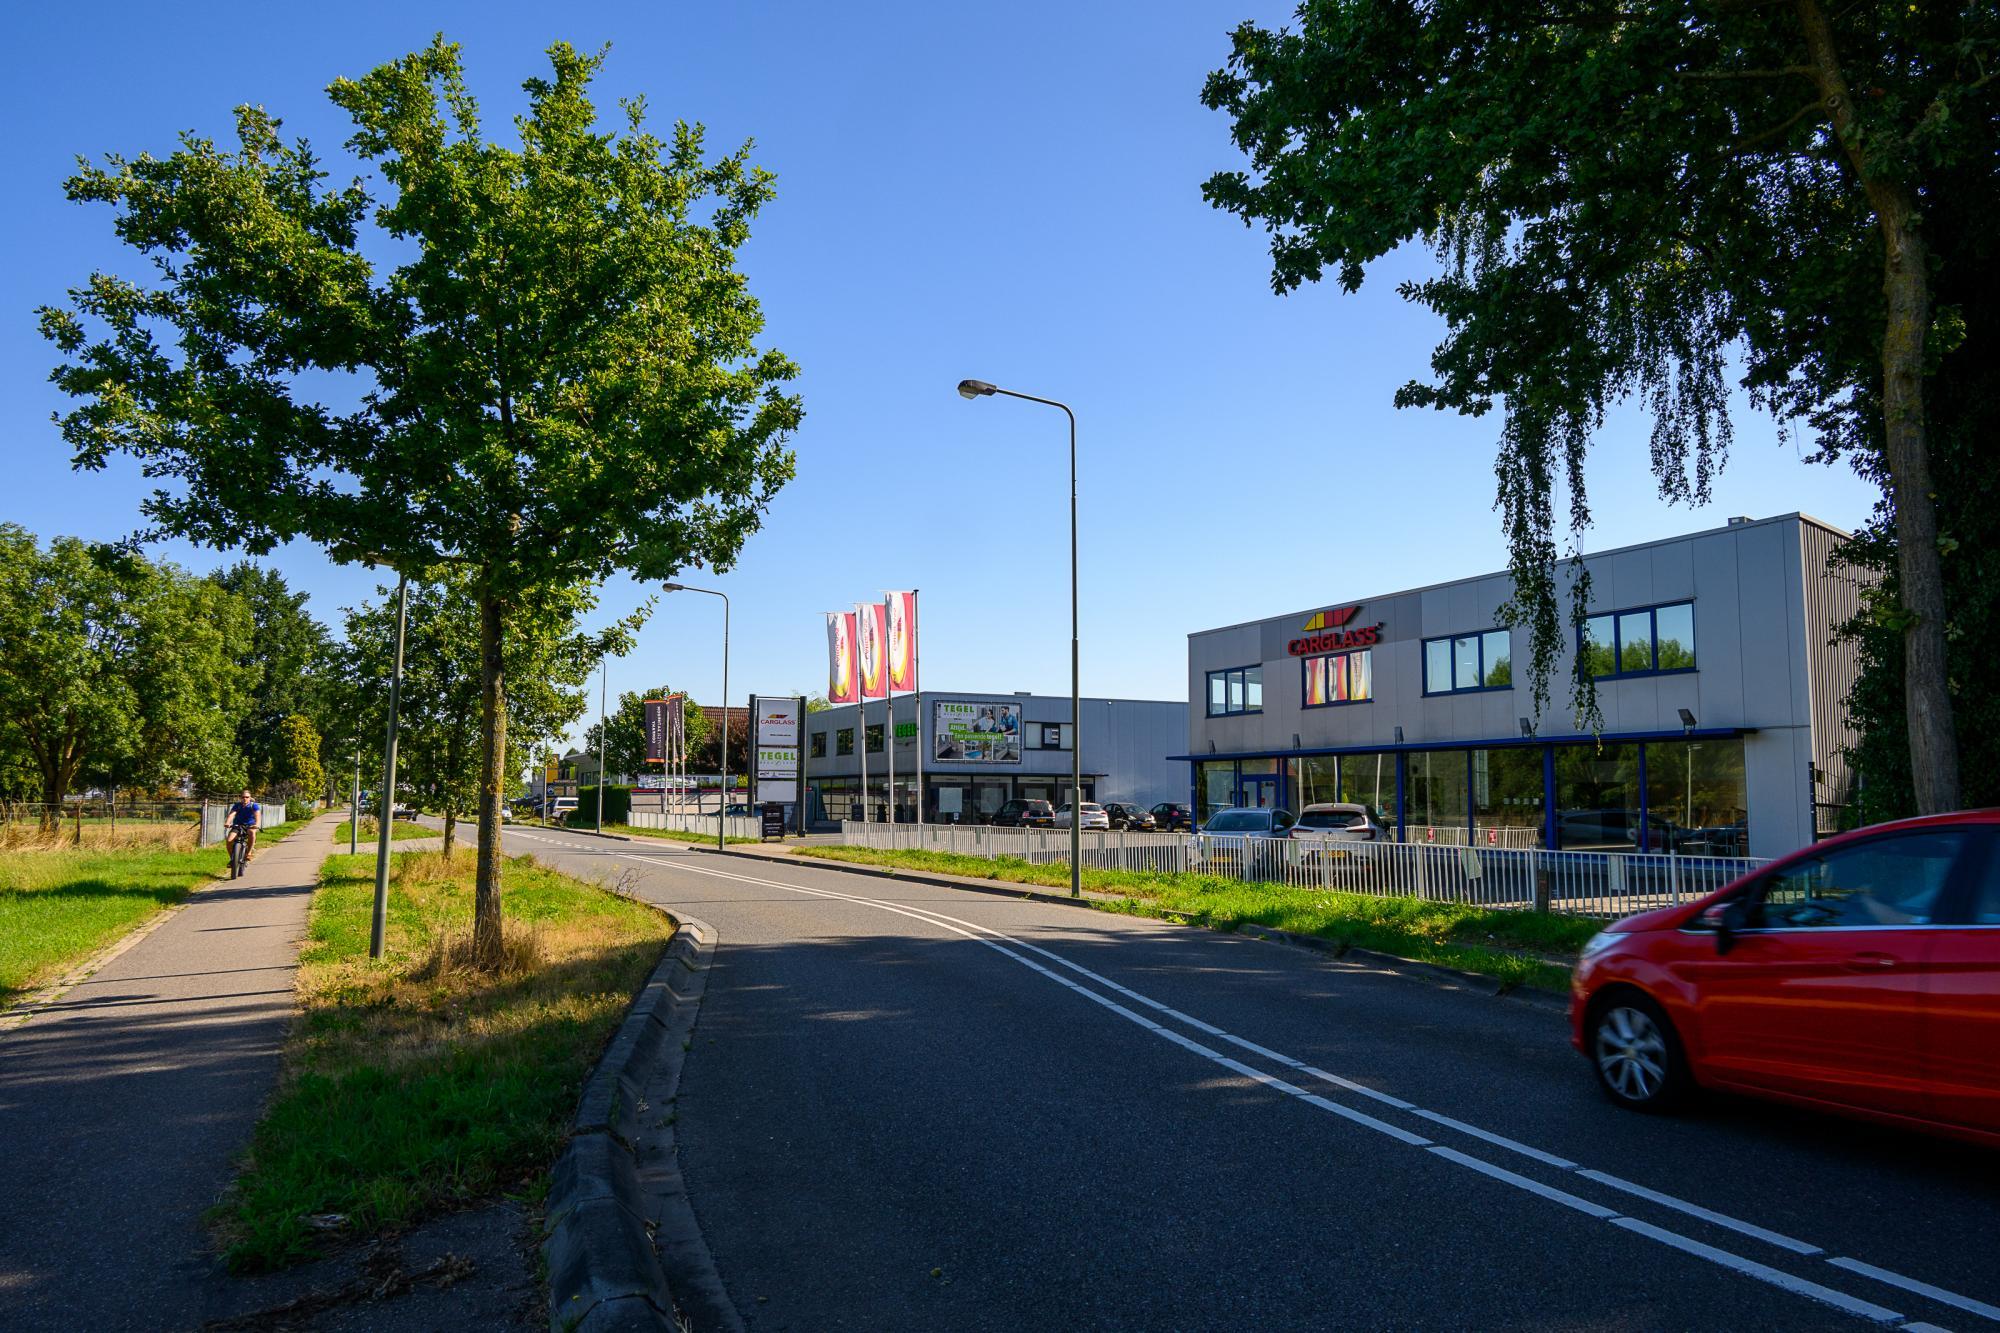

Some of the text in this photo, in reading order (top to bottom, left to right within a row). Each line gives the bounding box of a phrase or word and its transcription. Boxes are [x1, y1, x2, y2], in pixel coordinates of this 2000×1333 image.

[1288, 626, 1378, 656] CARGLASS
[944, 704, 974, 712] TEGEL
[760, 752, 796, 760] TEGEL
